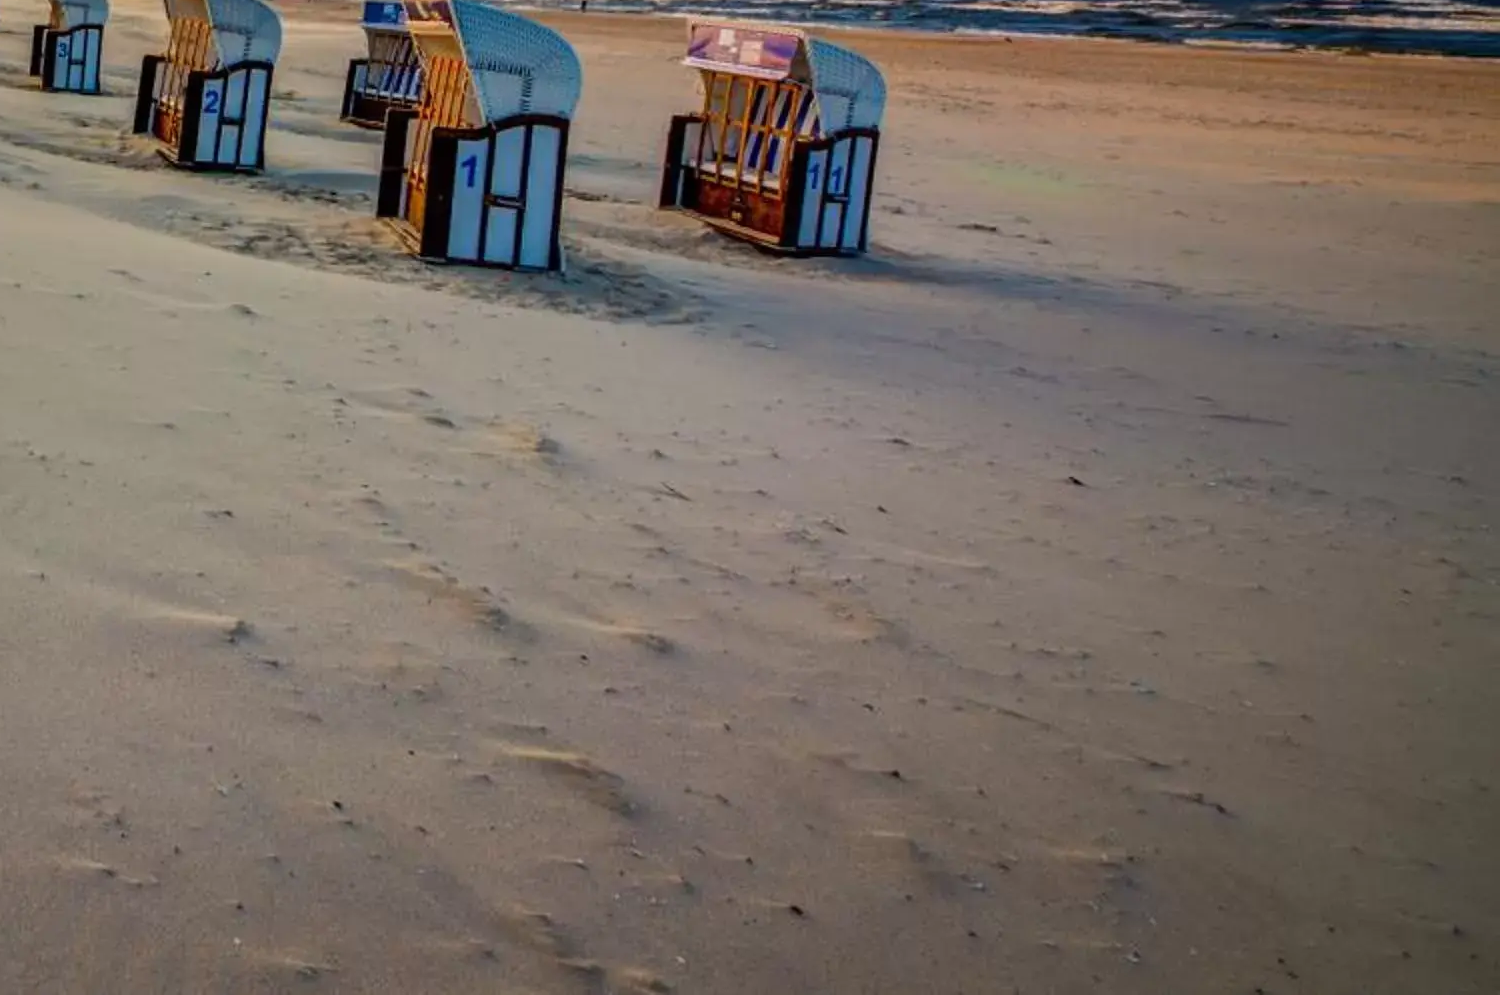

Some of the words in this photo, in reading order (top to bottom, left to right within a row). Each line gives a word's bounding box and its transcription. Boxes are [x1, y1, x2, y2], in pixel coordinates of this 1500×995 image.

[59, 43, 67, 57] 3
[204, 90, 219, 113] 2
[461, 155, 477, 187] 1
